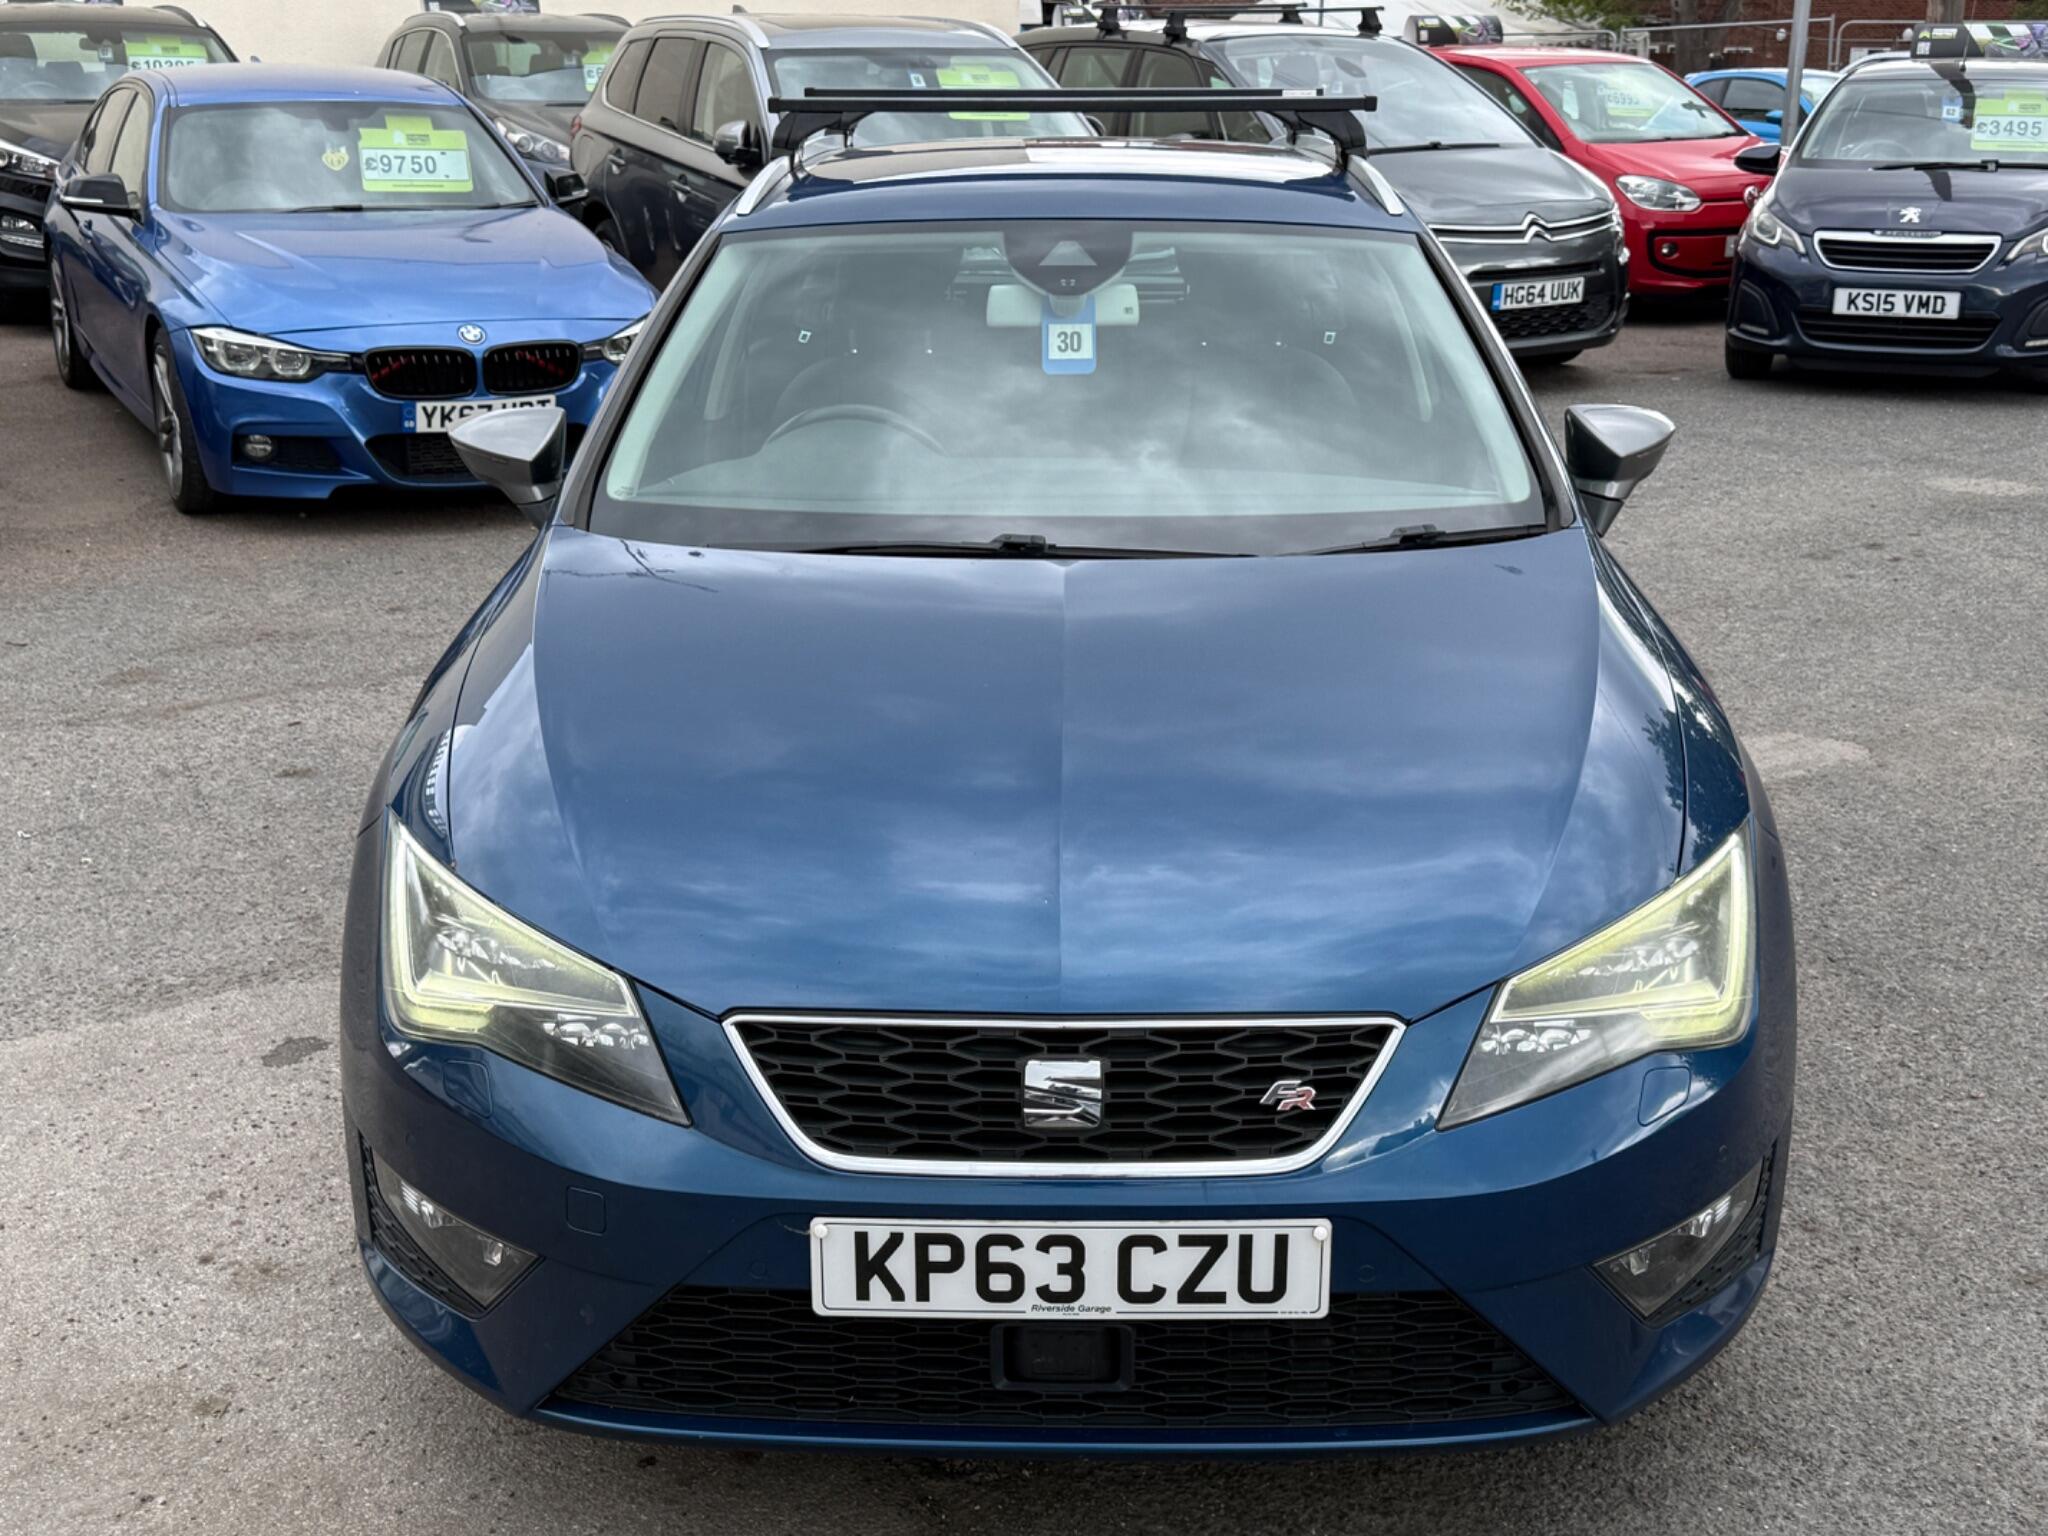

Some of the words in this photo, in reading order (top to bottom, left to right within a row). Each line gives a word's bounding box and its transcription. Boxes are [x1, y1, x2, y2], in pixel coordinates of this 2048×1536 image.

[131, 59, 195, 70] £10
[1976, 119, 2043, 137] £3495
[365, 154, 437, 174] £9750
[1503, 284, 1546, 305] HG64
[1551, 281, 1581, 301] UUK
[1846, 292, 1896, 313] KS15
[1903, 294, 1946, 315] VMD
[1056, 331, 1083, 353] 30
[1259, 1080, 1317, 1111] FR
[854, 1230, 1087, 1305] KP63
[1116, 1232, 1289, 1305] CZU
[1031, 1304, 1075, 1313] Riverside
[1078, 1304, 1112, 1314] Garage
